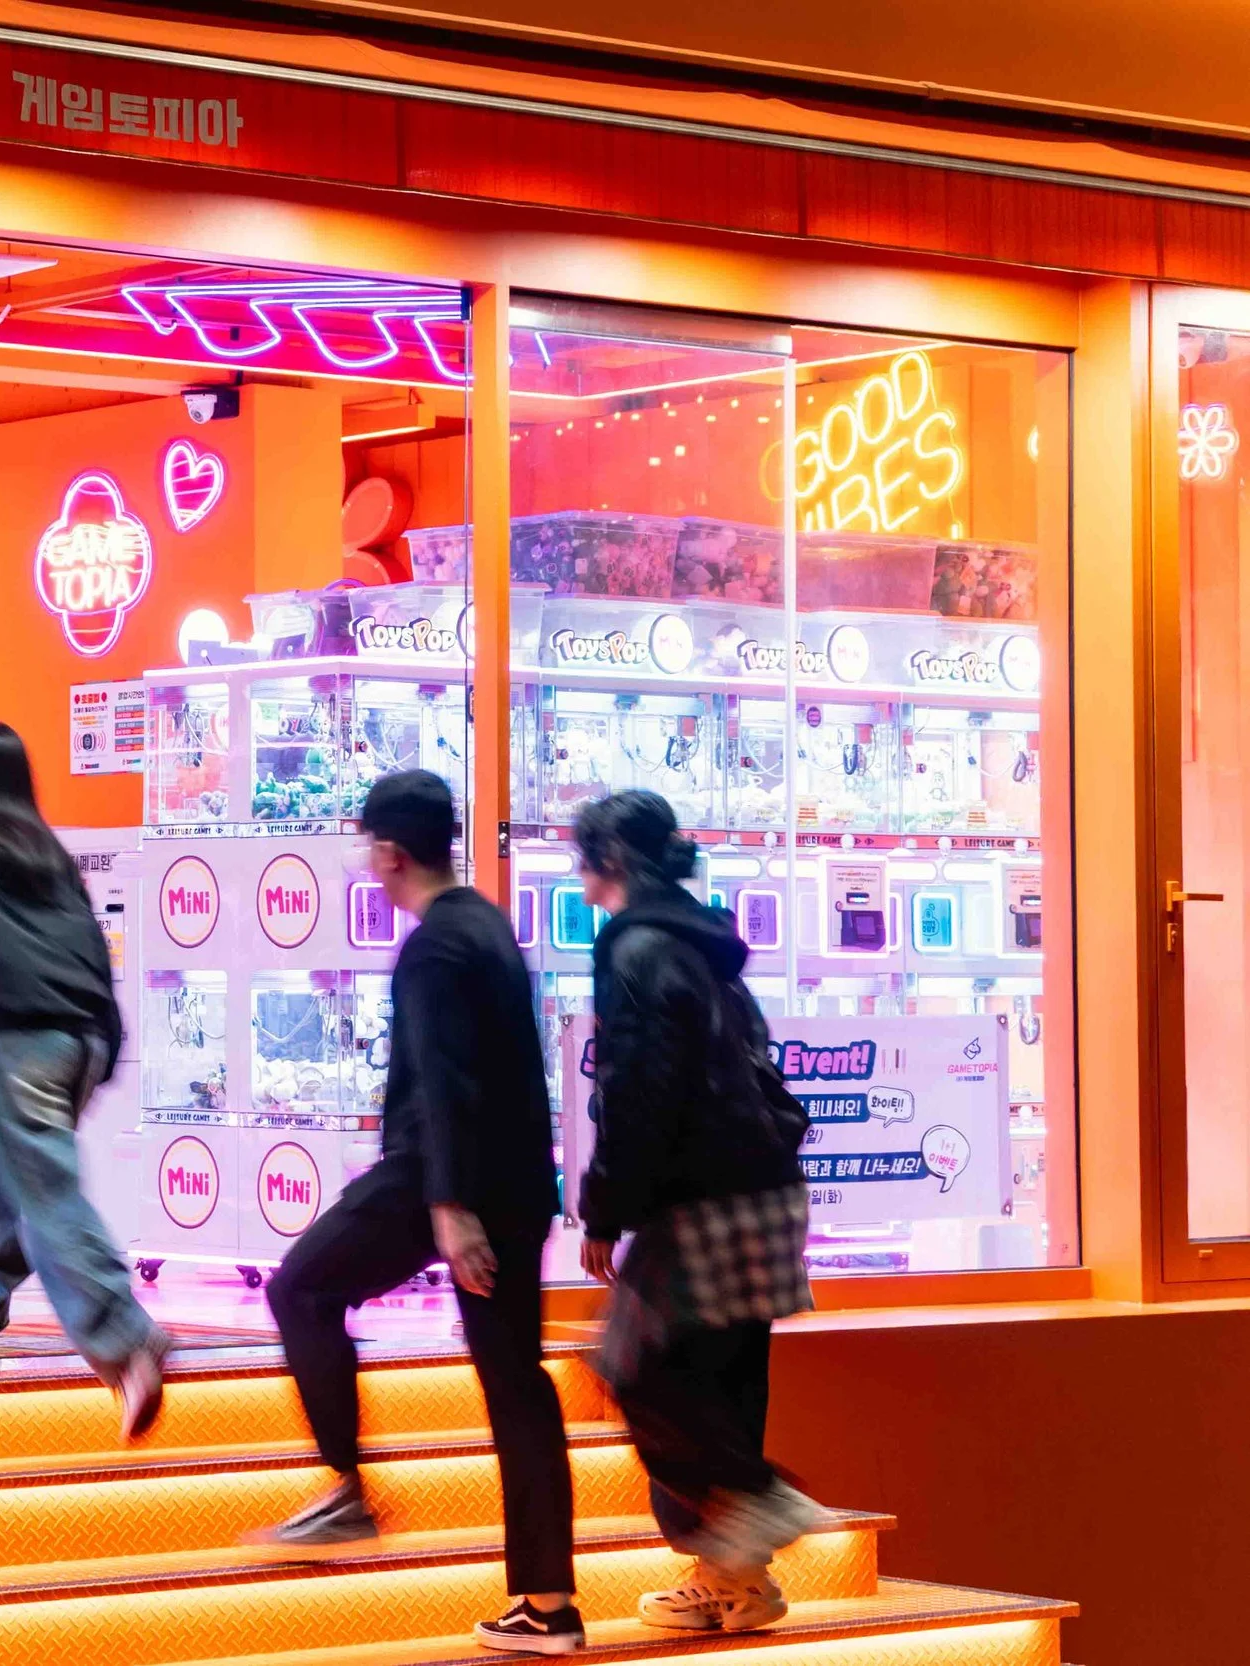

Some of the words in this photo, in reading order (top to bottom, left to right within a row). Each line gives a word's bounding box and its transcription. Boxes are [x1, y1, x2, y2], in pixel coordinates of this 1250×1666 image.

[12, 70, 244, 148] 게임토피아
[790, 351, 930, 499] GOOD
[46, 521, 137, 566] GAME
[49, 565, 132, 609] TOPIA
[168, 887, 210, 916] MiNi
[266, 886, 309, 916] MiNi
[781, 1042, 872, 1077] Event!
[947, 1062, 999, 1074] GAMETOPIA
[808, 1099, 861, 1117] 힘내세요!
[167, 1166, 210, 1196] MiNi
[836, 1158, 863, 1176] 함께
[864, 1157, 922, 1176] 나누세요!
[267, 1173, 310, 1205] MiNi
